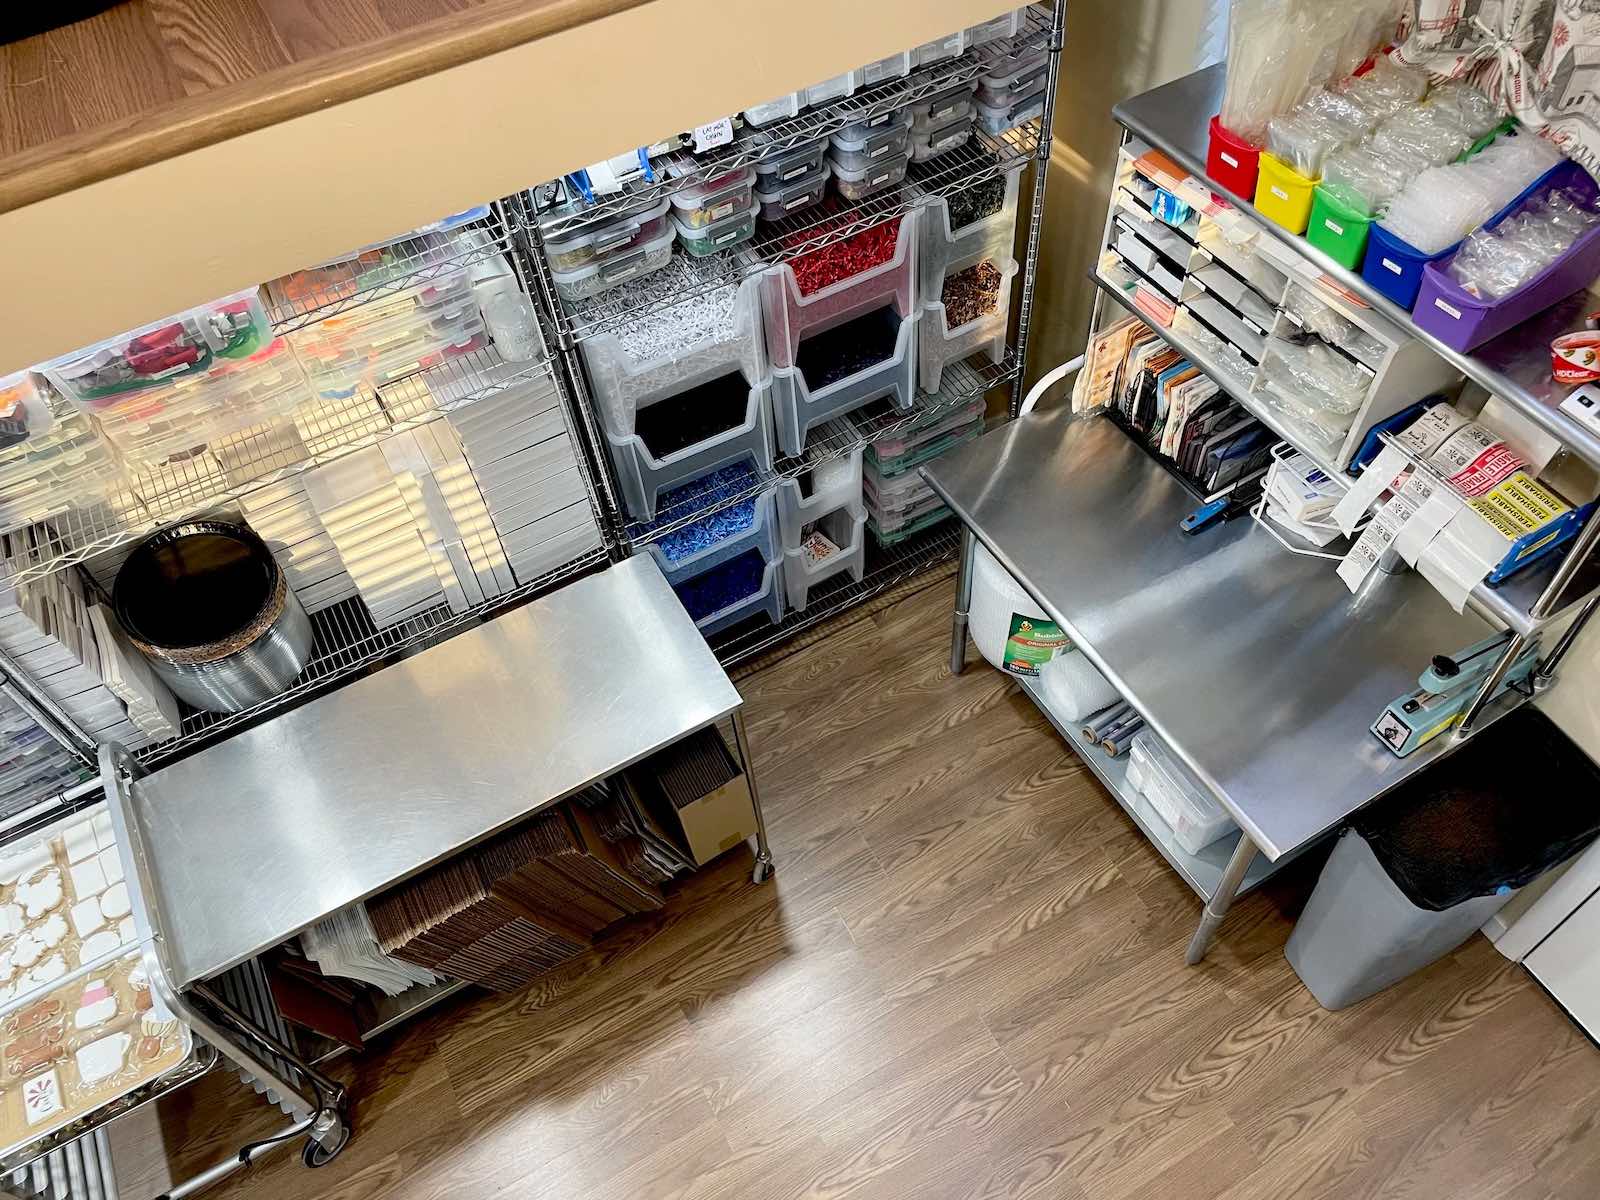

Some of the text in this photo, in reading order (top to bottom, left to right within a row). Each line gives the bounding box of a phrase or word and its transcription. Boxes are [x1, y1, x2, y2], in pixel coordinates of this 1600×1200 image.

[1505, 487, 1546, 520] PERISHABLE
[1518, 479, 1559, 512] PERISHABLE
[1472, 503, 1512, 537] PERISHABLE
[1491, 496, 1533, 529] PERISHABLE
[1026, 640, 1057, 648] ORIGINAL
